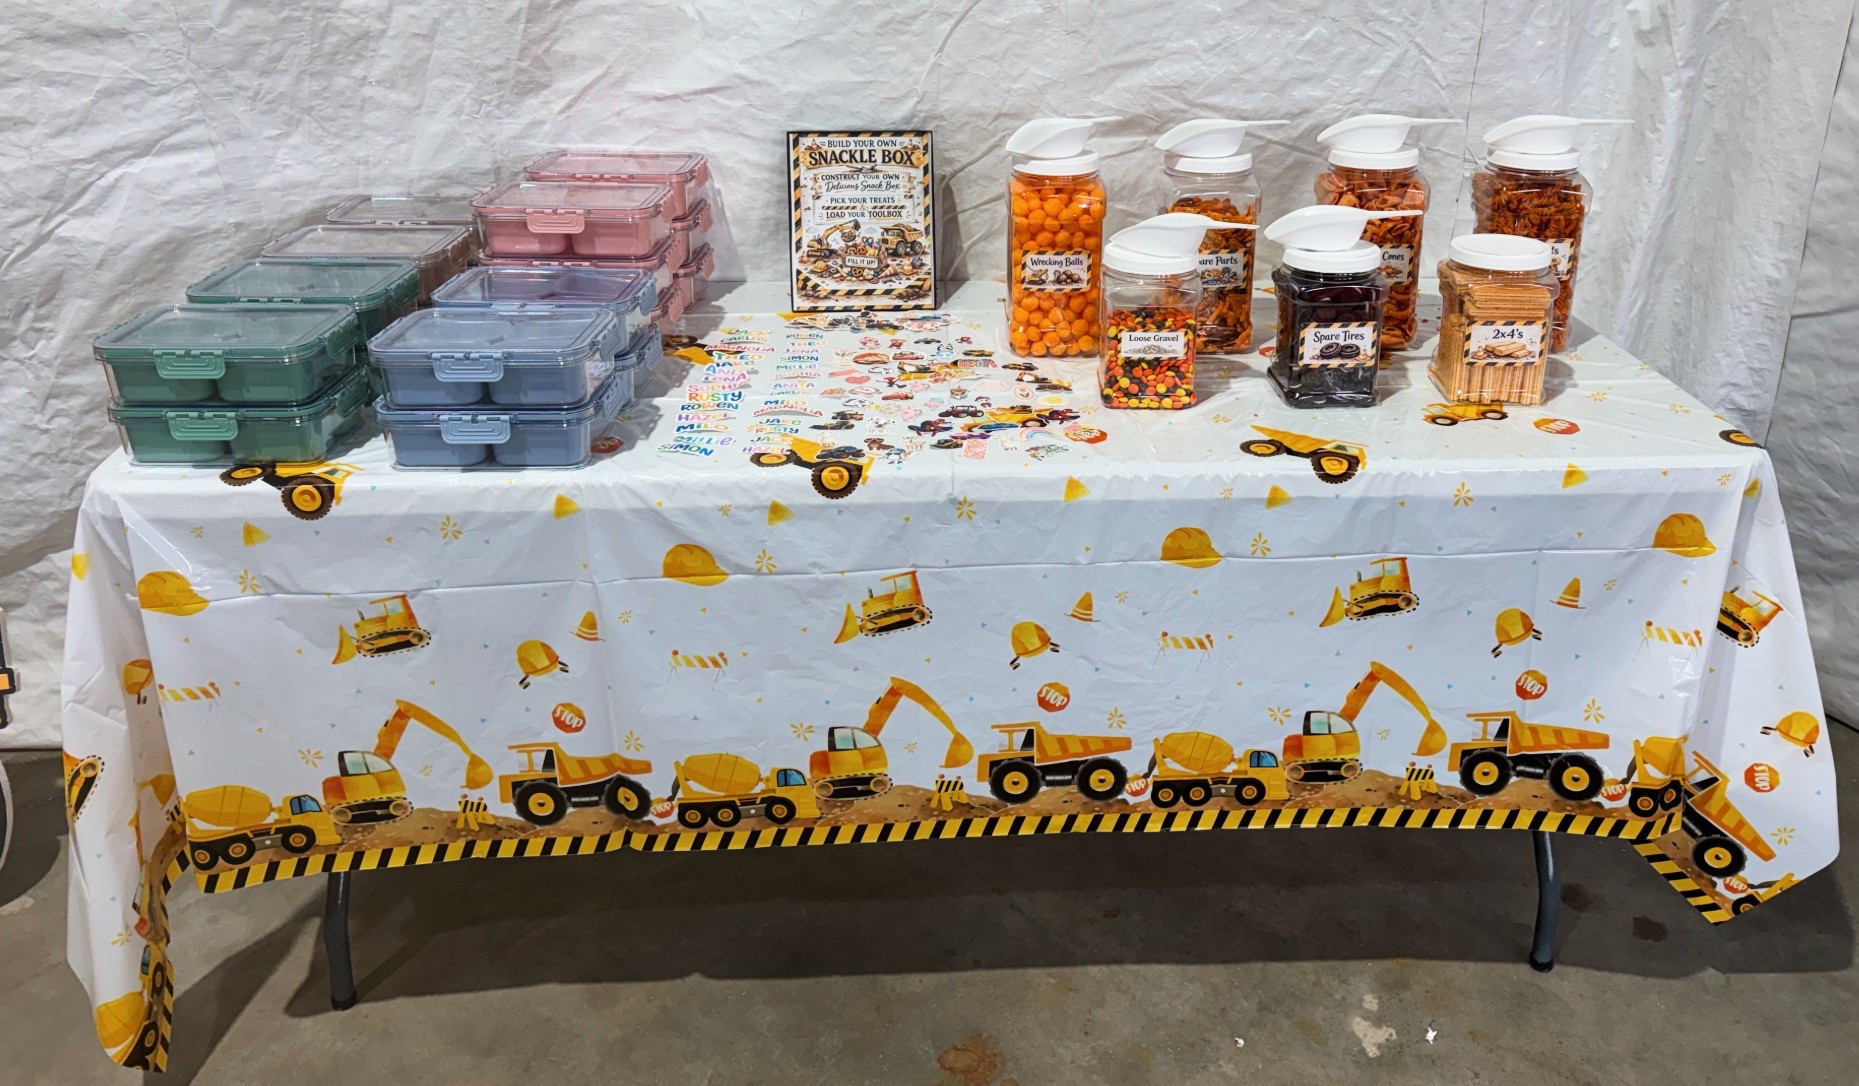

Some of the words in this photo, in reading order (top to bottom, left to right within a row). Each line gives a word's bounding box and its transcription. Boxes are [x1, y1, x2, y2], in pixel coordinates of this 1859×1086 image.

[827, 140, 851, 148] BUILD
[852, 139, 875, 147] YOUR
[876, 139, 898, 147] OWN
[808, 150, 877, 166] SNACKLE
[881, 150, 915, 166] BOX
[825, 181, 859, 192] Delicious
[860, 180, 884, 191] Snack
[885, 180, 901, 190] Box
[1030, 257, 1062, 268] Wrecking
[1064, 257, 1084, 266] Balls
[1215, 256, 1238, 266] Parts
[1382, 251, 1405, 261] Cones
[1129, 334, 1151, 342] Loose
[1153, 334, 1179, 342] Gravel
[1313, 331, 1341, 344] Spare
[1343, 331, 1365, 341] Tires
[1492, 329, 1524, 339] 2x4's
[715, 352, 763, 360] THEO
[1517, 674, 1544, 695] STOP
[1039, 685, 1068, 707] STOP
[553, 705, 584, 729] STOP
[1754, 765, 1771, 791] STOP
[1125, 778, 1147, 794] STOP
[1601, 783, 1627, 797] STOP
[651, 801, 672, 814] STOP
[1725, 876, 1748, 891] STOP
